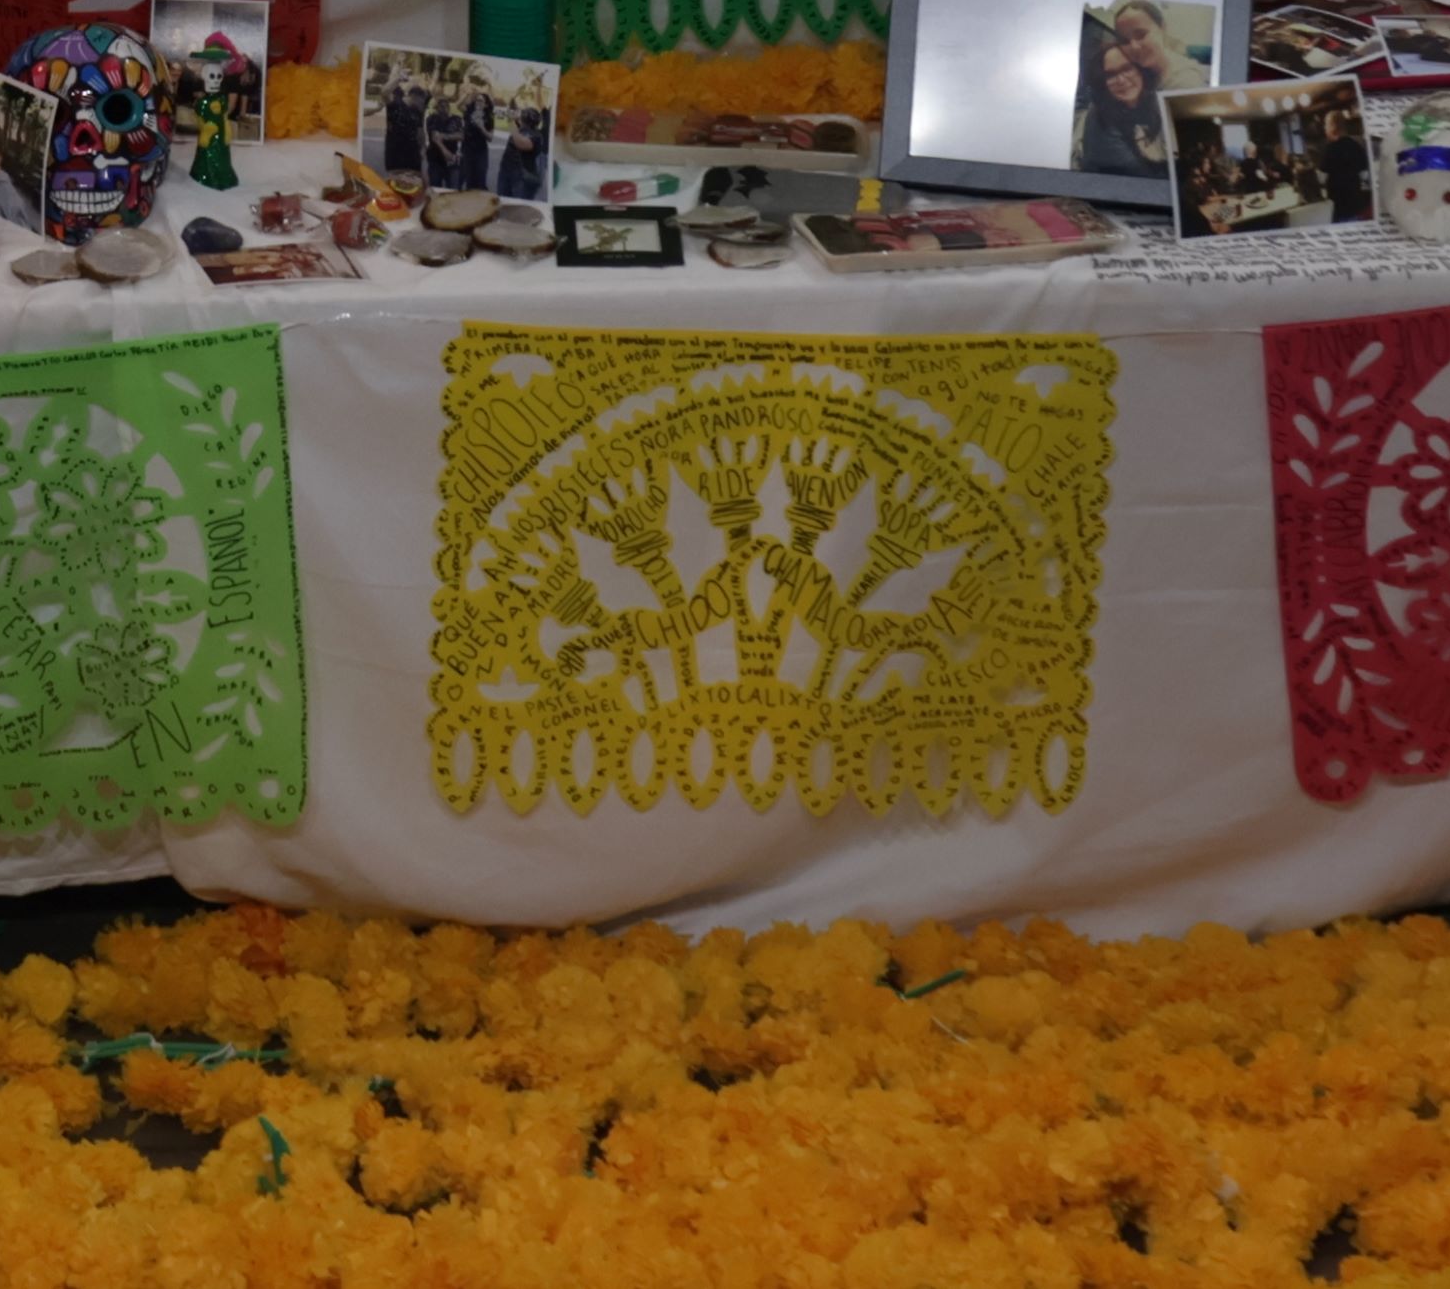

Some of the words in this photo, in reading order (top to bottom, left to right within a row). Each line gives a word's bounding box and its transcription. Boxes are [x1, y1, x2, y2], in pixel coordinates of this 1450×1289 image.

[956, 402, 1044, 475] PATO
[698, 467, 757, 503] RIDE
[634, 577, 733, 650] CHIDO
[127, 700, 194, 770] EN
